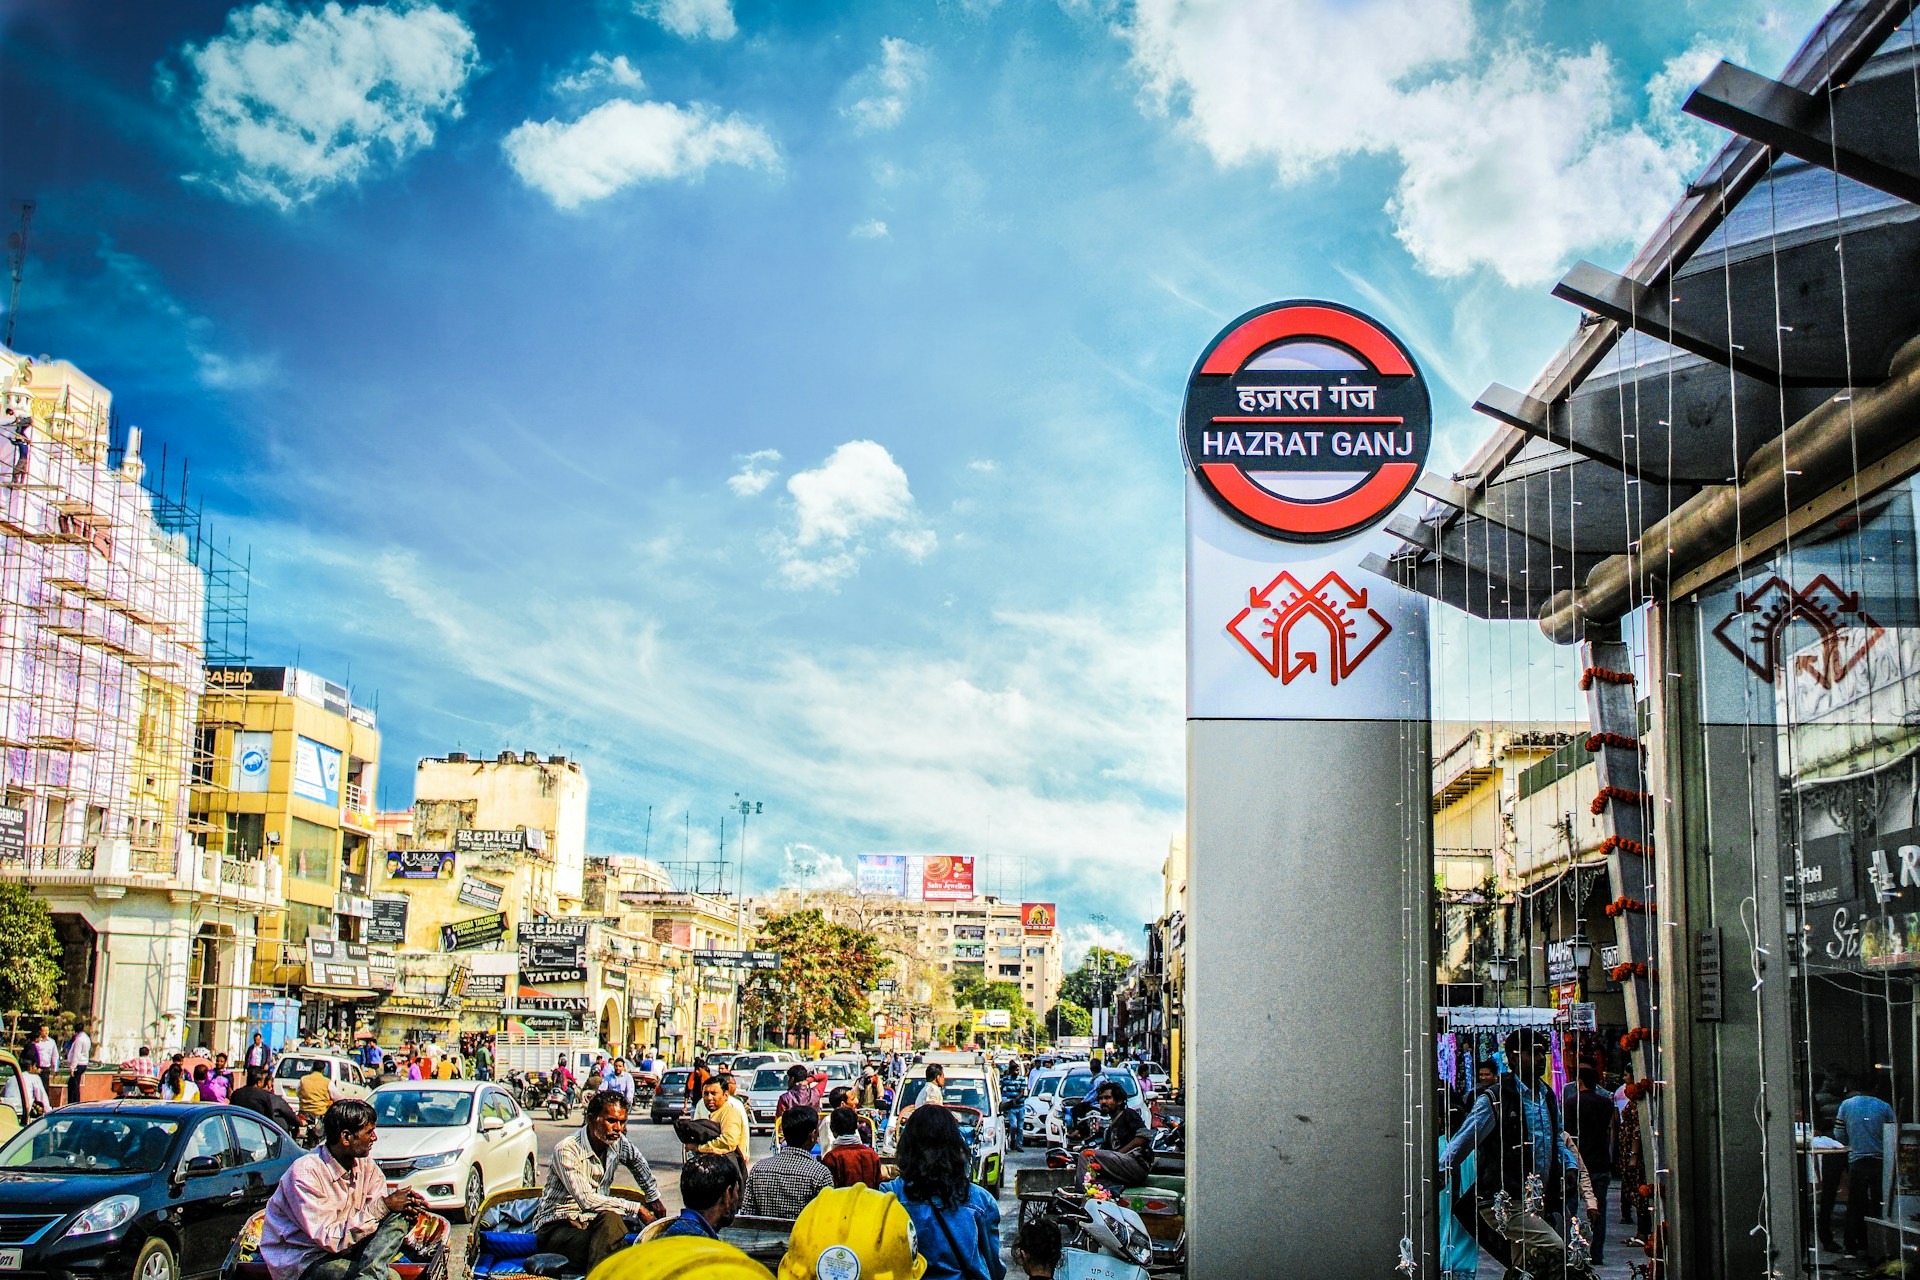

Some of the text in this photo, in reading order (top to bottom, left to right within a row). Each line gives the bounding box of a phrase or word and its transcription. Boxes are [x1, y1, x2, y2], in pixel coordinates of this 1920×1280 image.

[1236, 378, 1378, 412] हज़रत गंज
[1203, 431, 1414, 457] HAZRAT GANJ
[206, 671, 253, 684] CASIO
[457, 830, 523, 844] Replay
[412, 852, 440, 861] RAZA
[943, 882, 971, 891] Jewellers
[452, 915, 500, 932] CUSTOM TAILORING
[519, 923, 586, 937] Replay
[314, 942, 332, 955] CASIO
[713, 951, 743, 959] PARKING
[753, 952, 775, 960] ENTRY
[326, 963, 356, 976] UNIVERSAL
[528, 969, 581, 983] TATTOO
[536, 998, 588, 1010] TITAN
